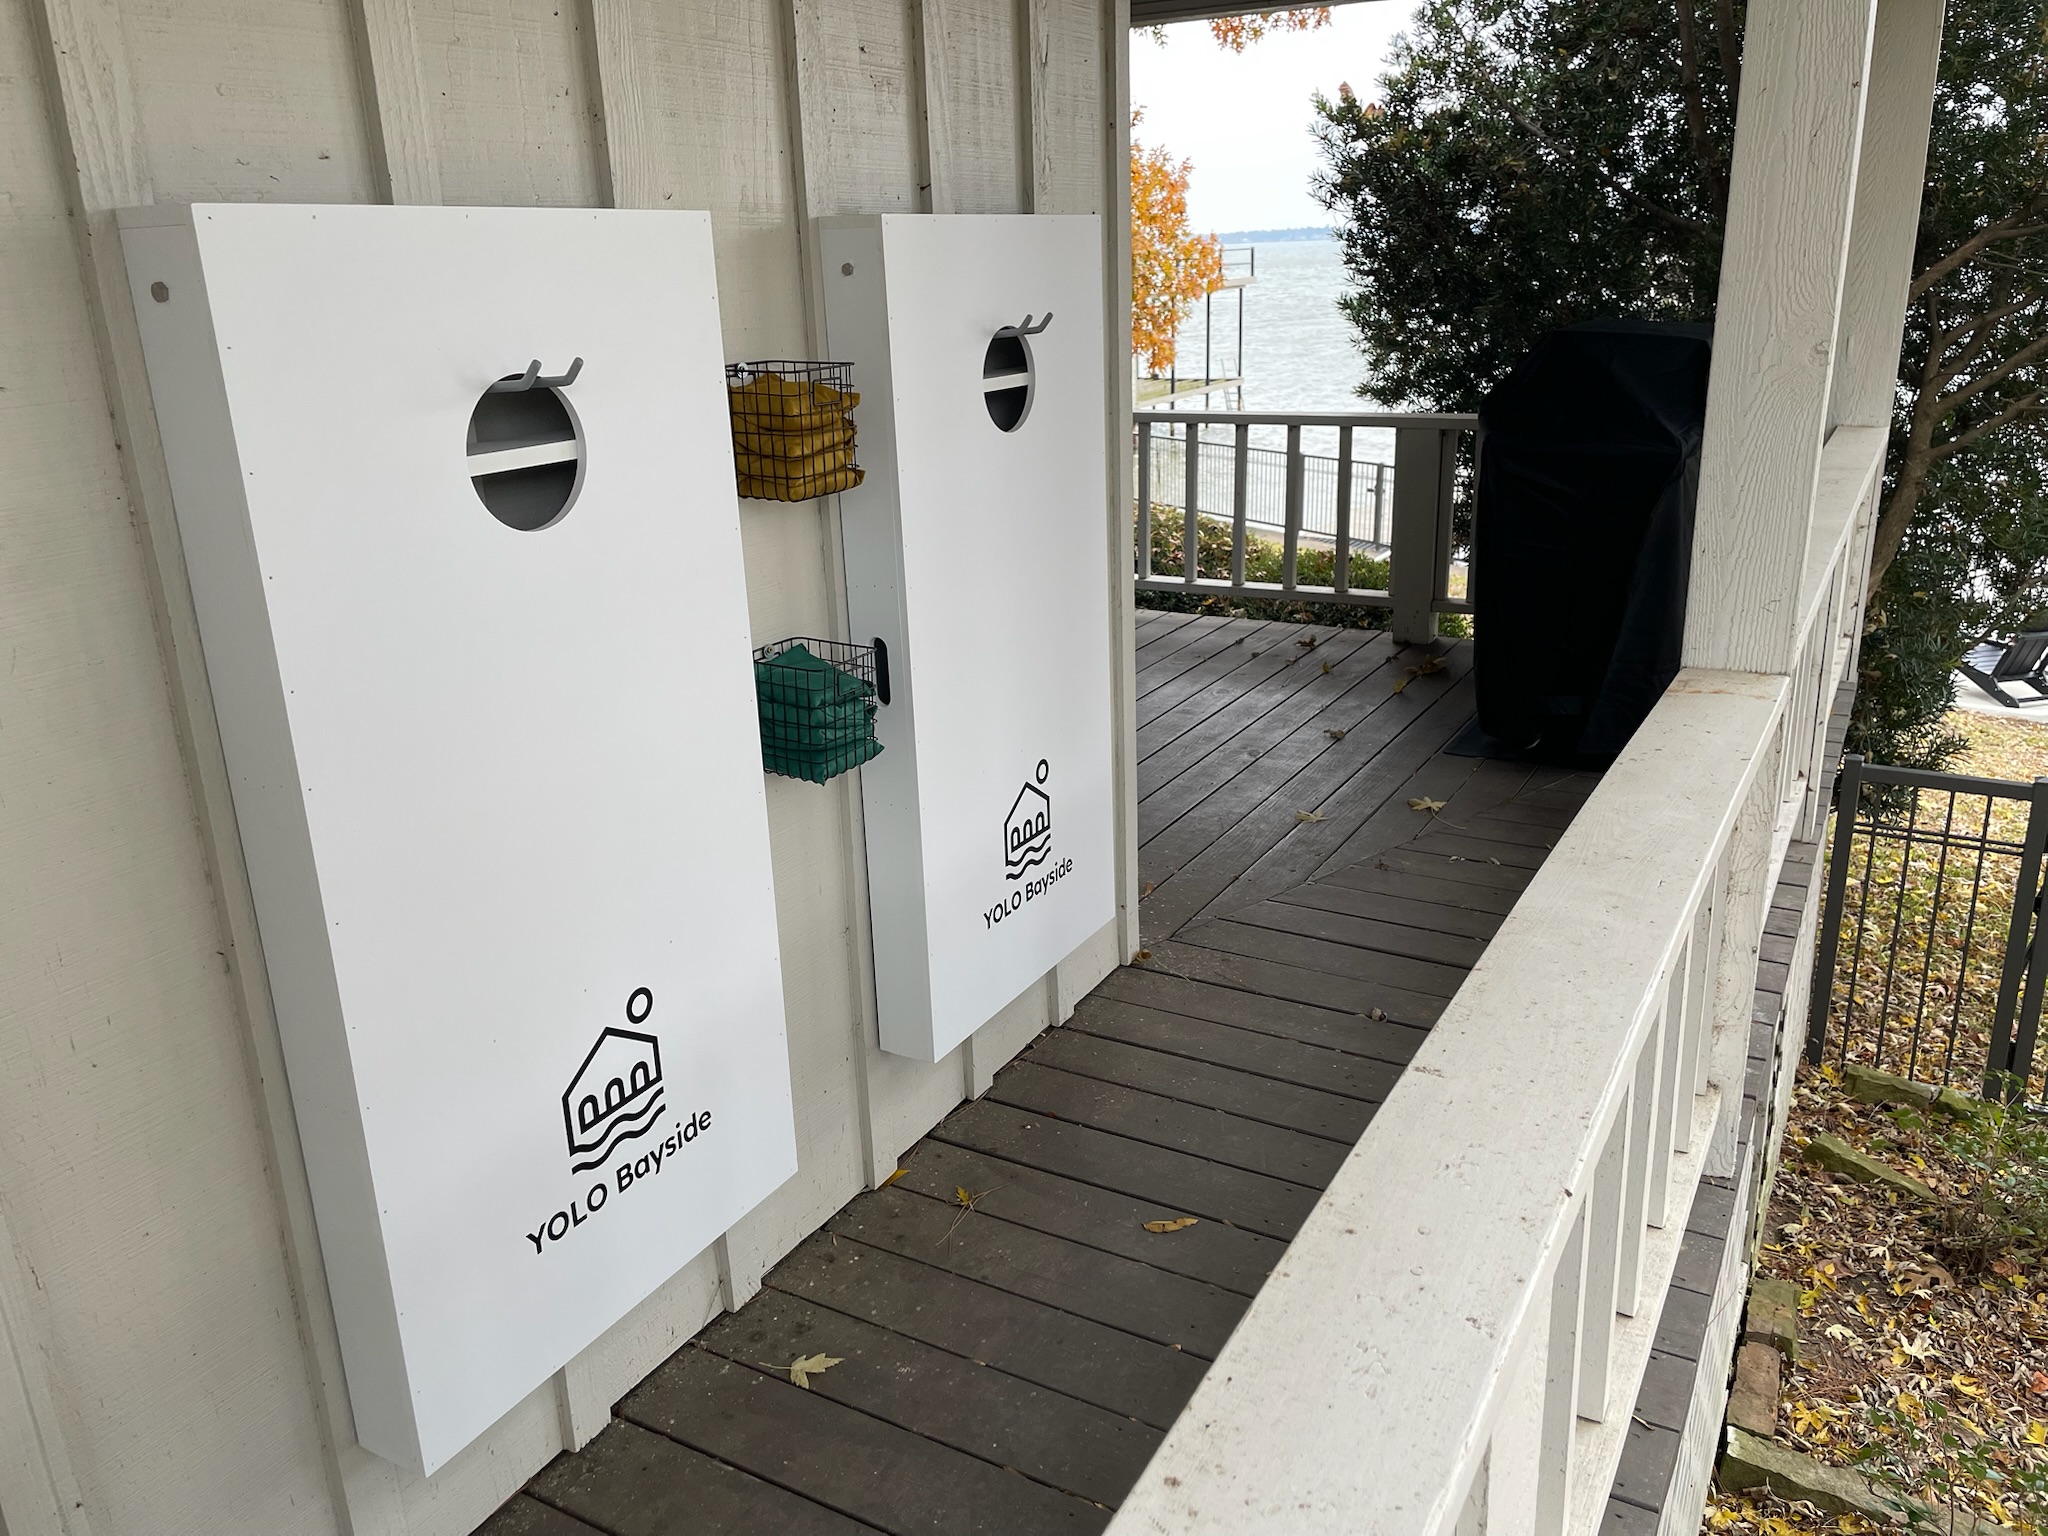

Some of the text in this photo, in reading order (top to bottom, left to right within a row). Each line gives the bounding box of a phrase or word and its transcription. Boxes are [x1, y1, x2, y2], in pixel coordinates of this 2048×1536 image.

[983, 857, 1073, 930] YOLO Bayside
[525, 1110, 712, 1255] YOLO Bayside
